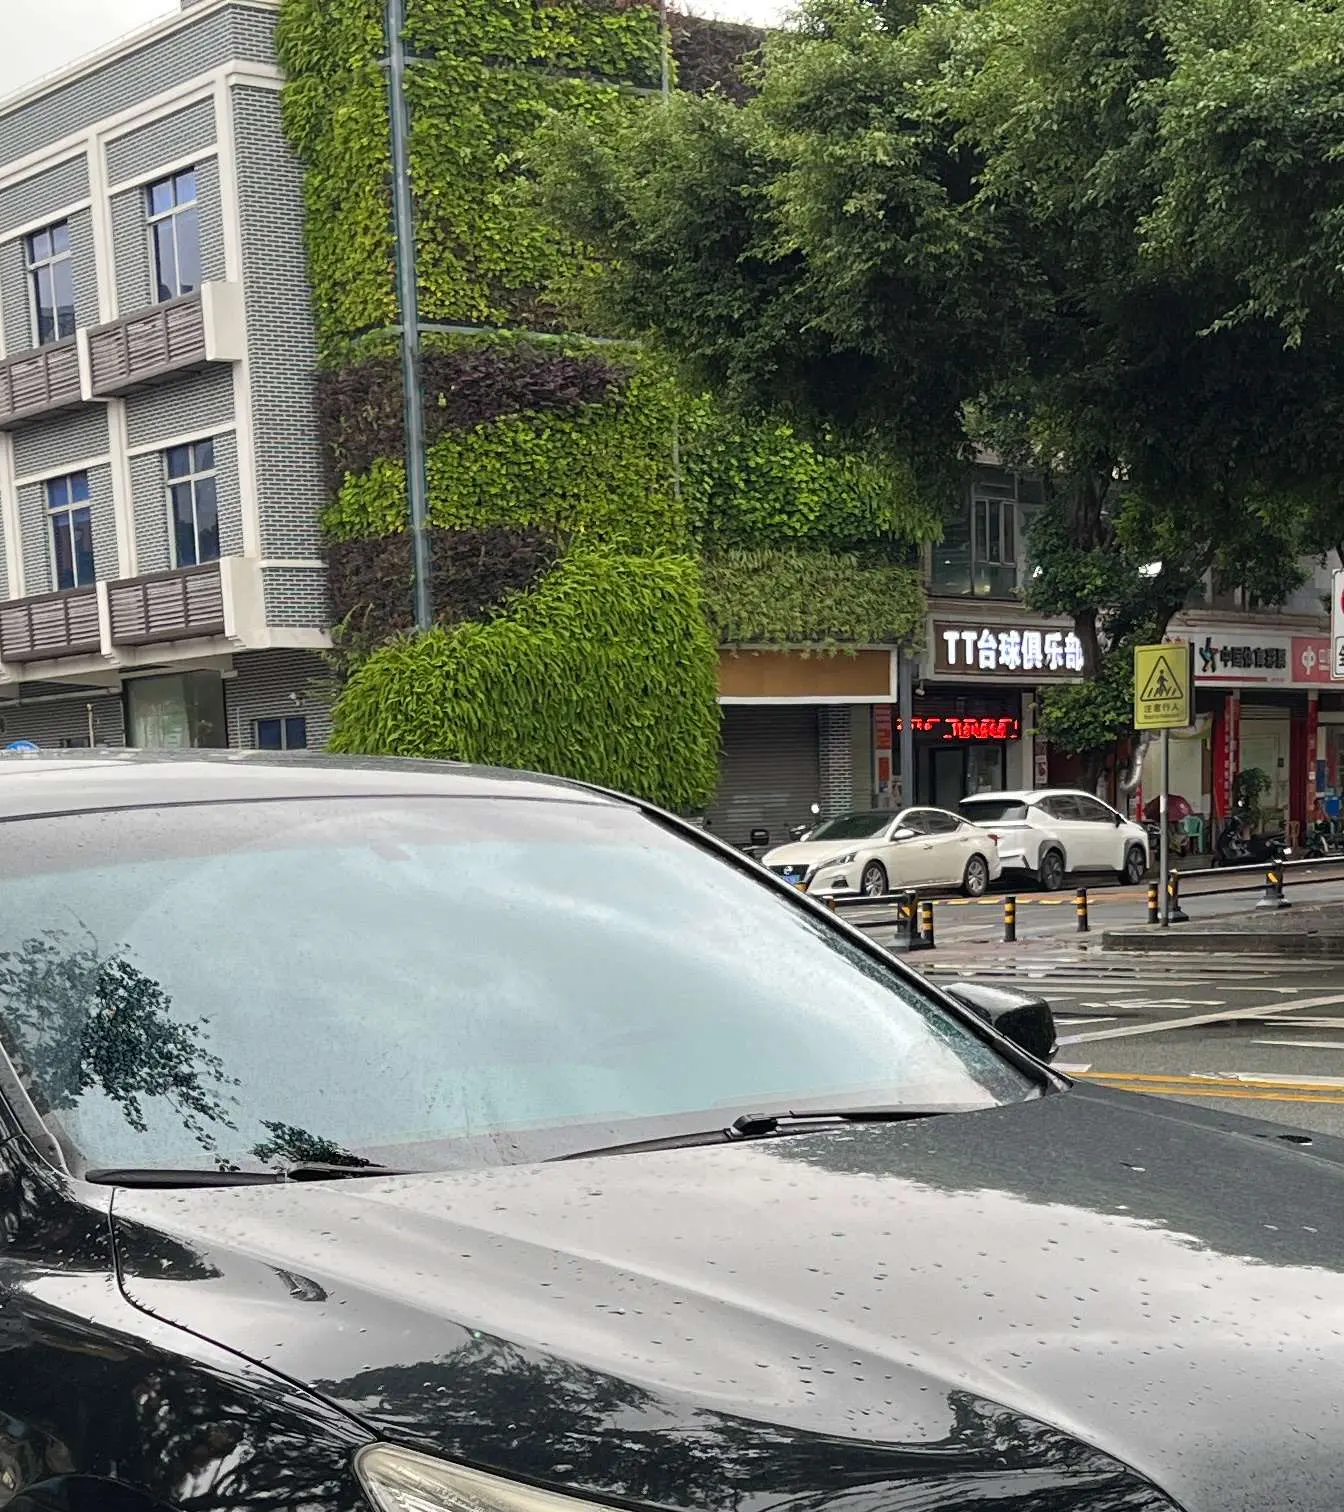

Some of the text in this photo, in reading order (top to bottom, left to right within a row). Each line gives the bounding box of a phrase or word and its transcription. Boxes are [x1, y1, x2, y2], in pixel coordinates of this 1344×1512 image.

[943, 629, 1084, 671] TT台球俱乐部
